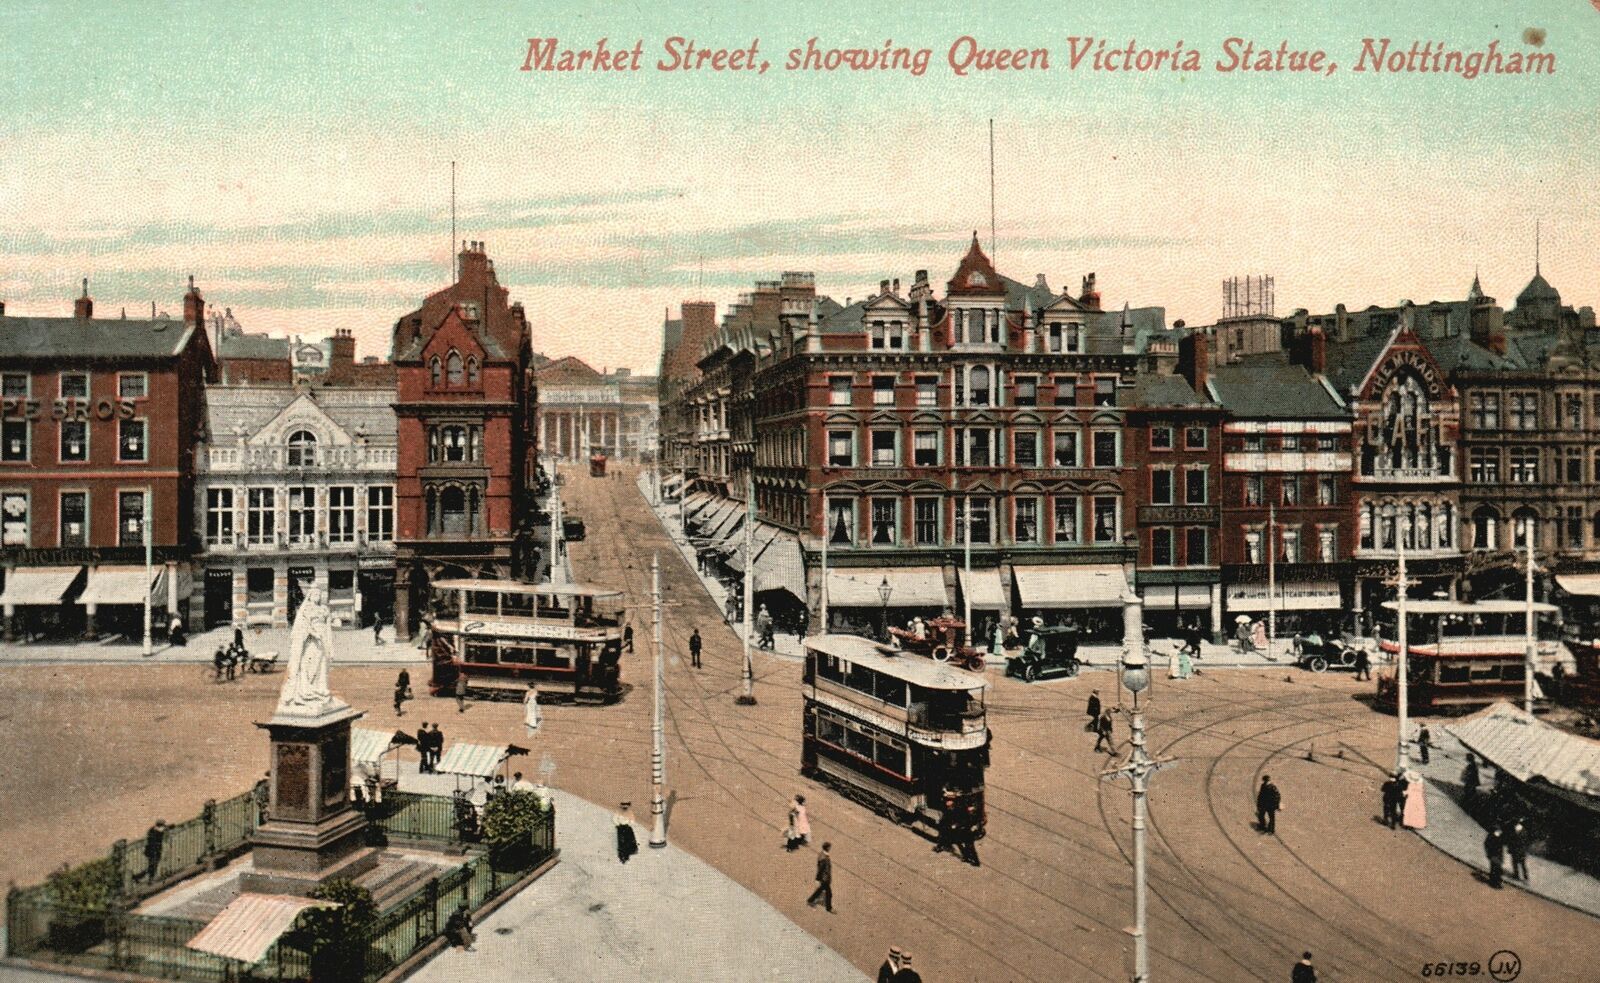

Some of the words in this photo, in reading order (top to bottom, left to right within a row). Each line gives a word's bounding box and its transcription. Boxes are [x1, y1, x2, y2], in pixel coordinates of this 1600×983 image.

[1371, 365, 1393, 396] THE
[1390, 351, 1440, 394] MIKADO
[52, 400, 136, 421] BROS
